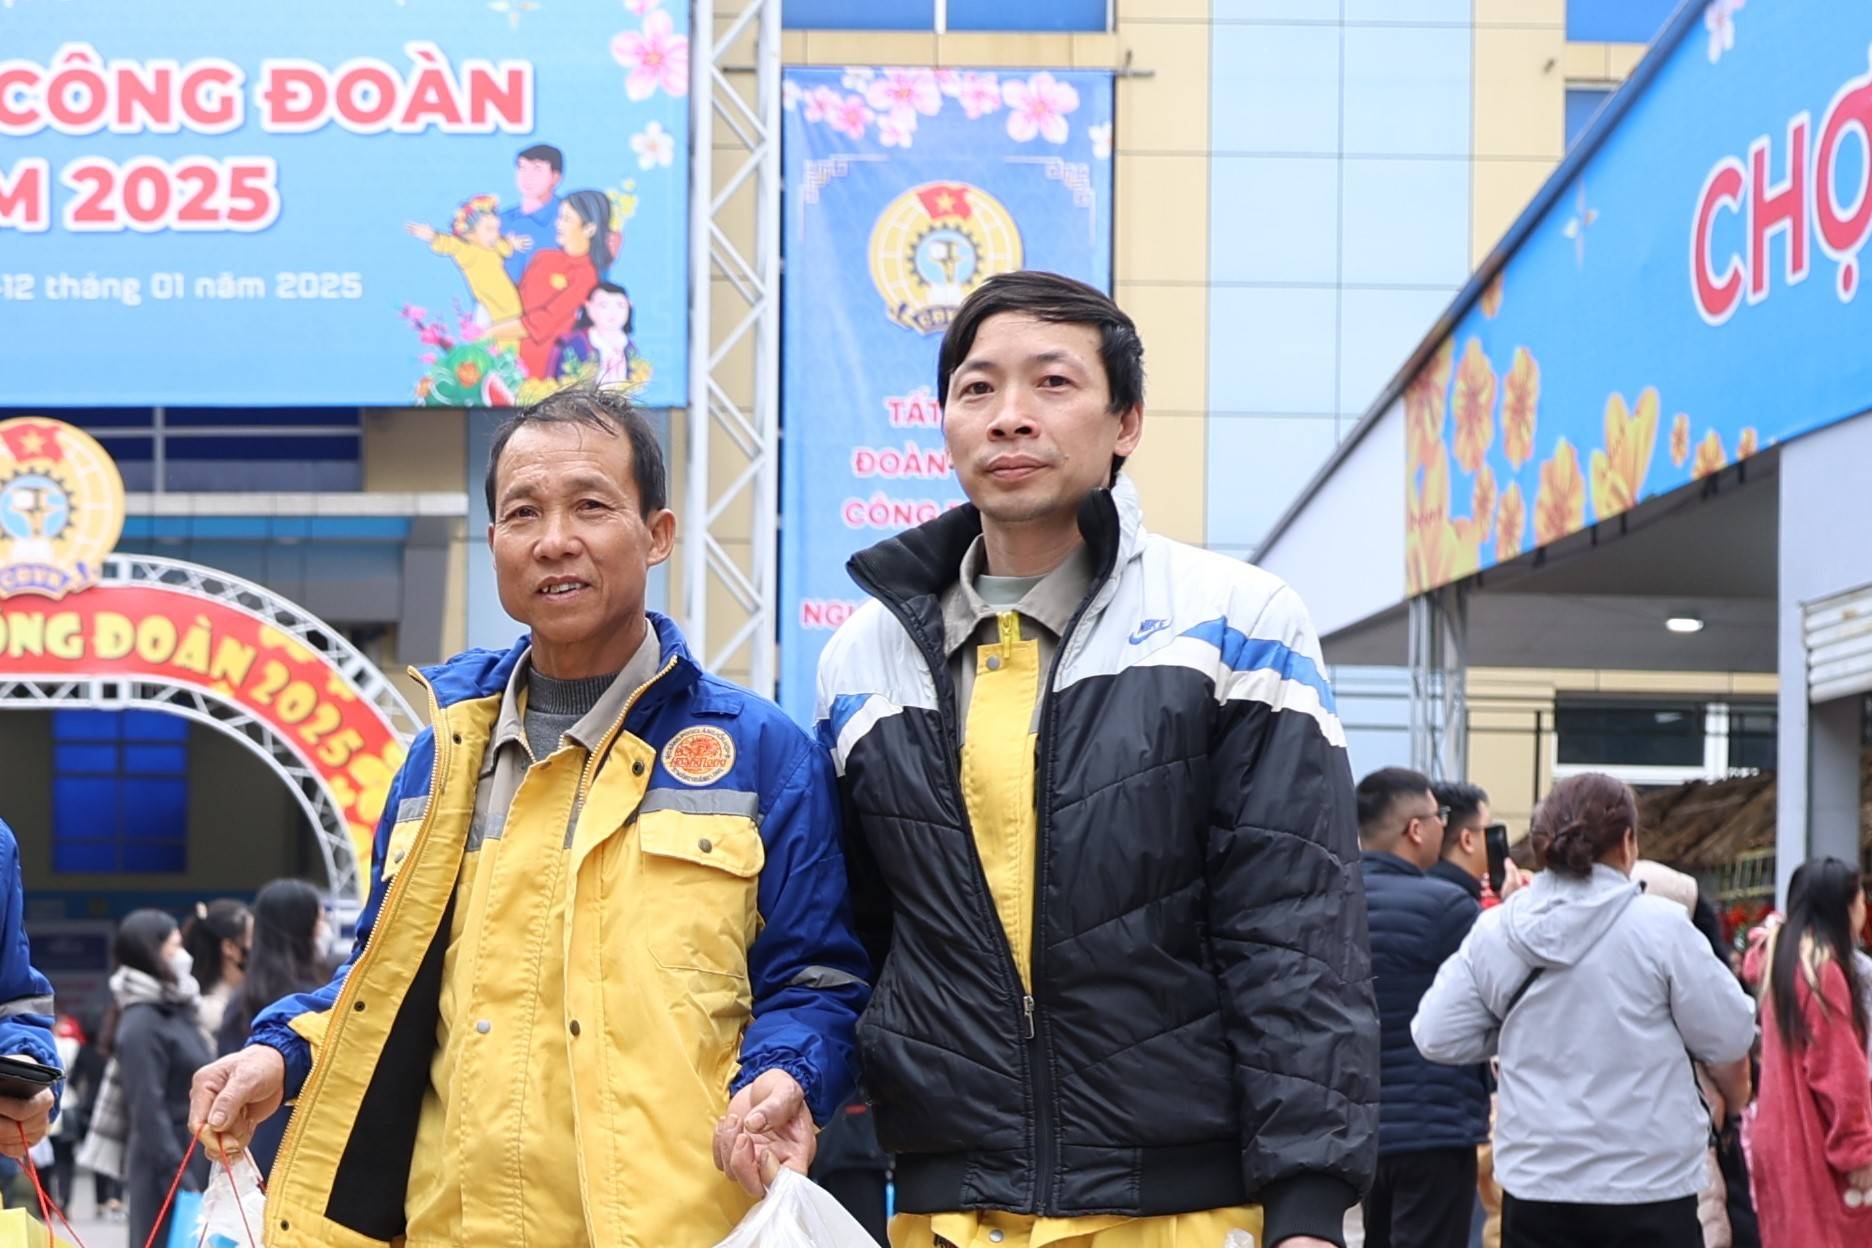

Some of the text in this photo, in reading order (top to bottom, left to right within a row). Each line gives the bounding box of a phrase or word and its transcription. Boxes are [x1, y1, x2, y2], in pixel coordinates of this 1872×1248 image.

[260, 47, 528, 129] ĐOÀN
[67, 161, 276, 228] 2025
[45, 271, 142, 306] tháng
[150, 272, 185, 301] 01
[193, 271, 266, 301] năm
[276, 271, 364, 301] 2025
[854, 445, 947, 476] ĐOÀN
[843, 495, 937, 527] CÔNG
[1138, 617, 1169, 632] NIKE
[92, 612, 259, 689] ĐOÀN
[250, 659, 366, 771] 2025
